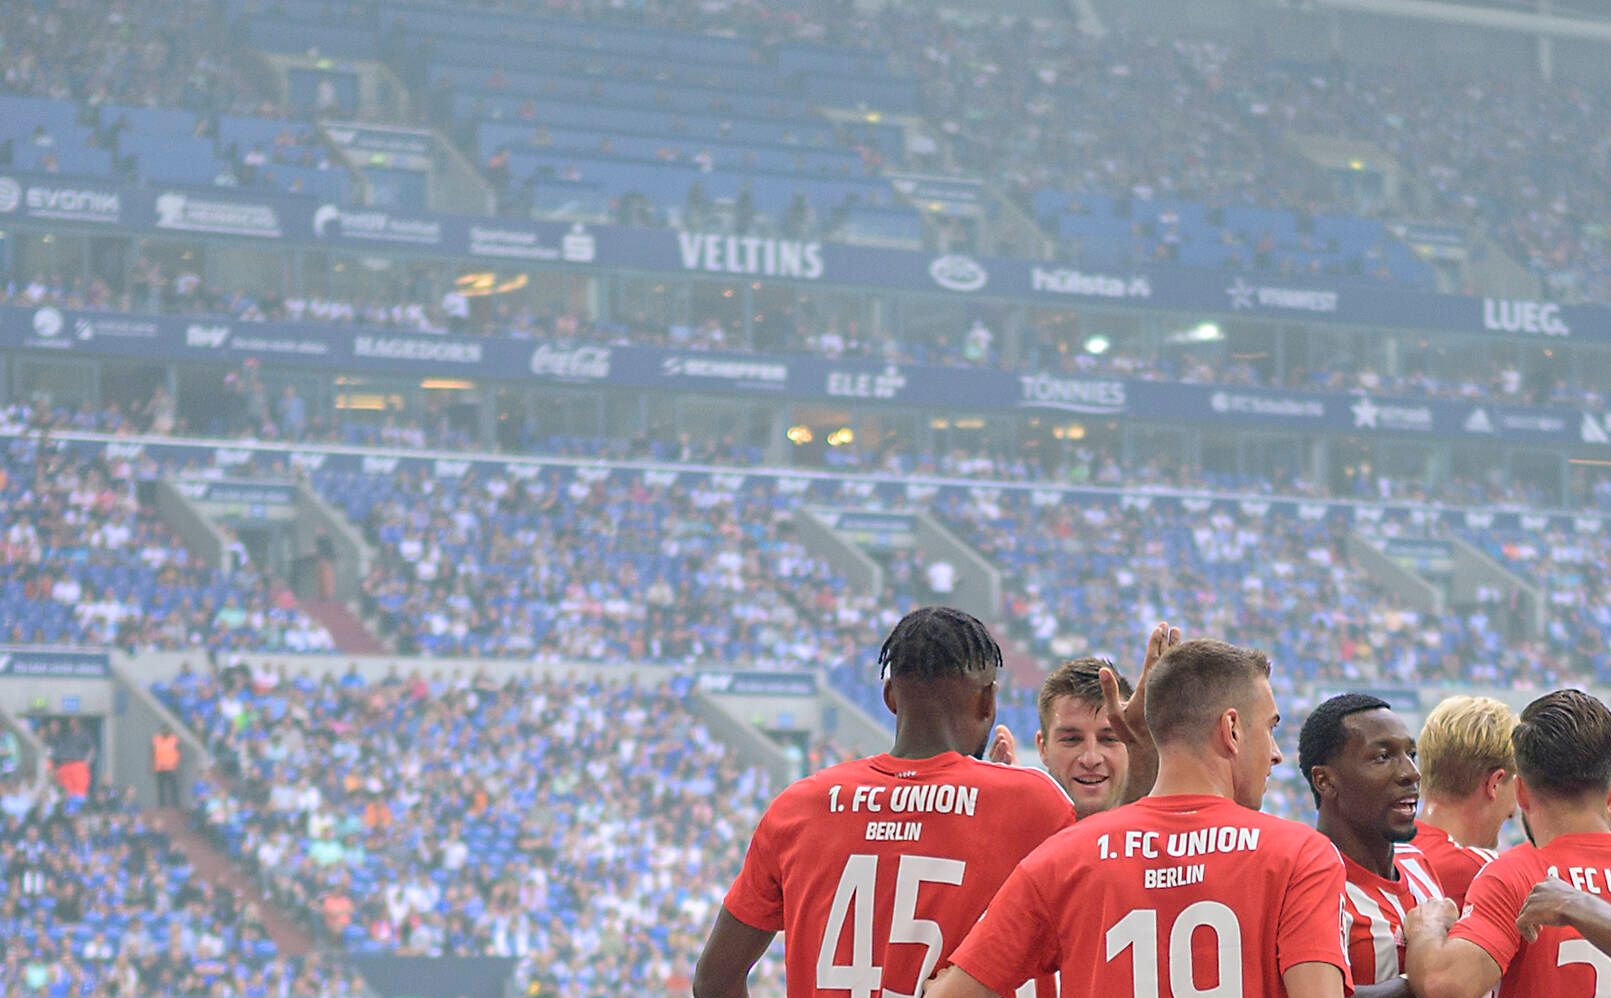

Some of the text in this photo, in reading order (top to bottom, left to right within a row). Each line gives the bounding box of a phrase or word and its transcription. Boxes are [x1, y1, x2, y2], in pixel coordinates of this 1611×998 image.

[678, 231, 824, 279] VELTINS
[826, 372, 870, 398] ELE
[829, 784, 979, 816] 1. FC UNION
[865, 822, 923, 841] BERLIN
[1097, 826, 1260, 860] 1. FC UNION
[1144, 864, 1205, 889] BERLIN
[1568, 866, 1601, 894] FC
